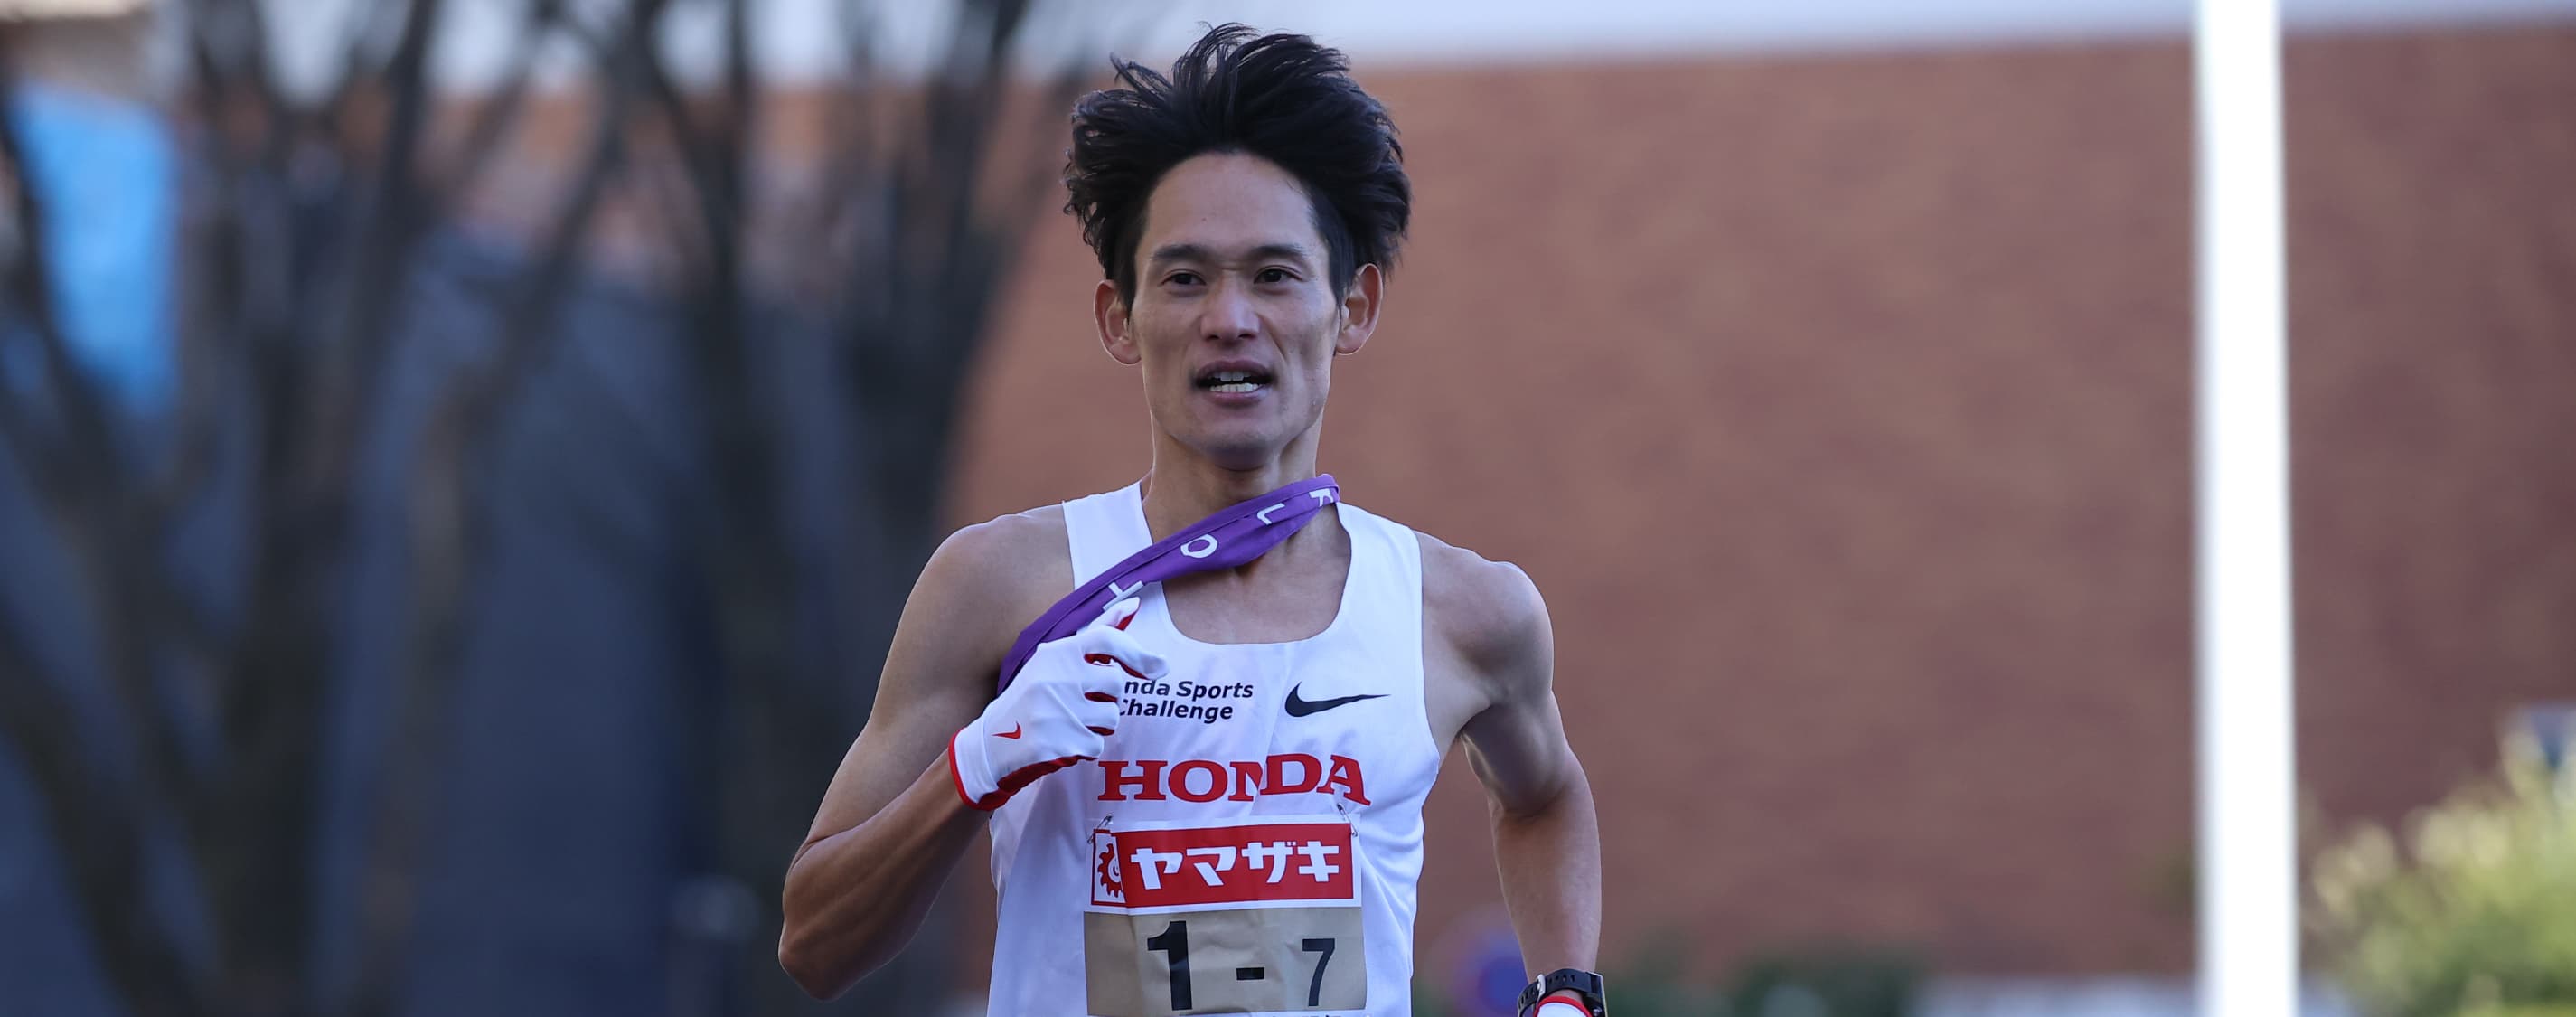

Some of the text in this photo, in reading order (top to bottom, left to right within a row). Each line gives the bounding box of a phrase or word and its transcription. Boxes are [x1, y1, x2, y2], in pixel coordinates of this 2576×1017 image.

[1176, 681, 1254, 702] Sports
[1097, 753, 1371, 806] HONDA
[1130, 841, 1340, 890] ヤマザキ
